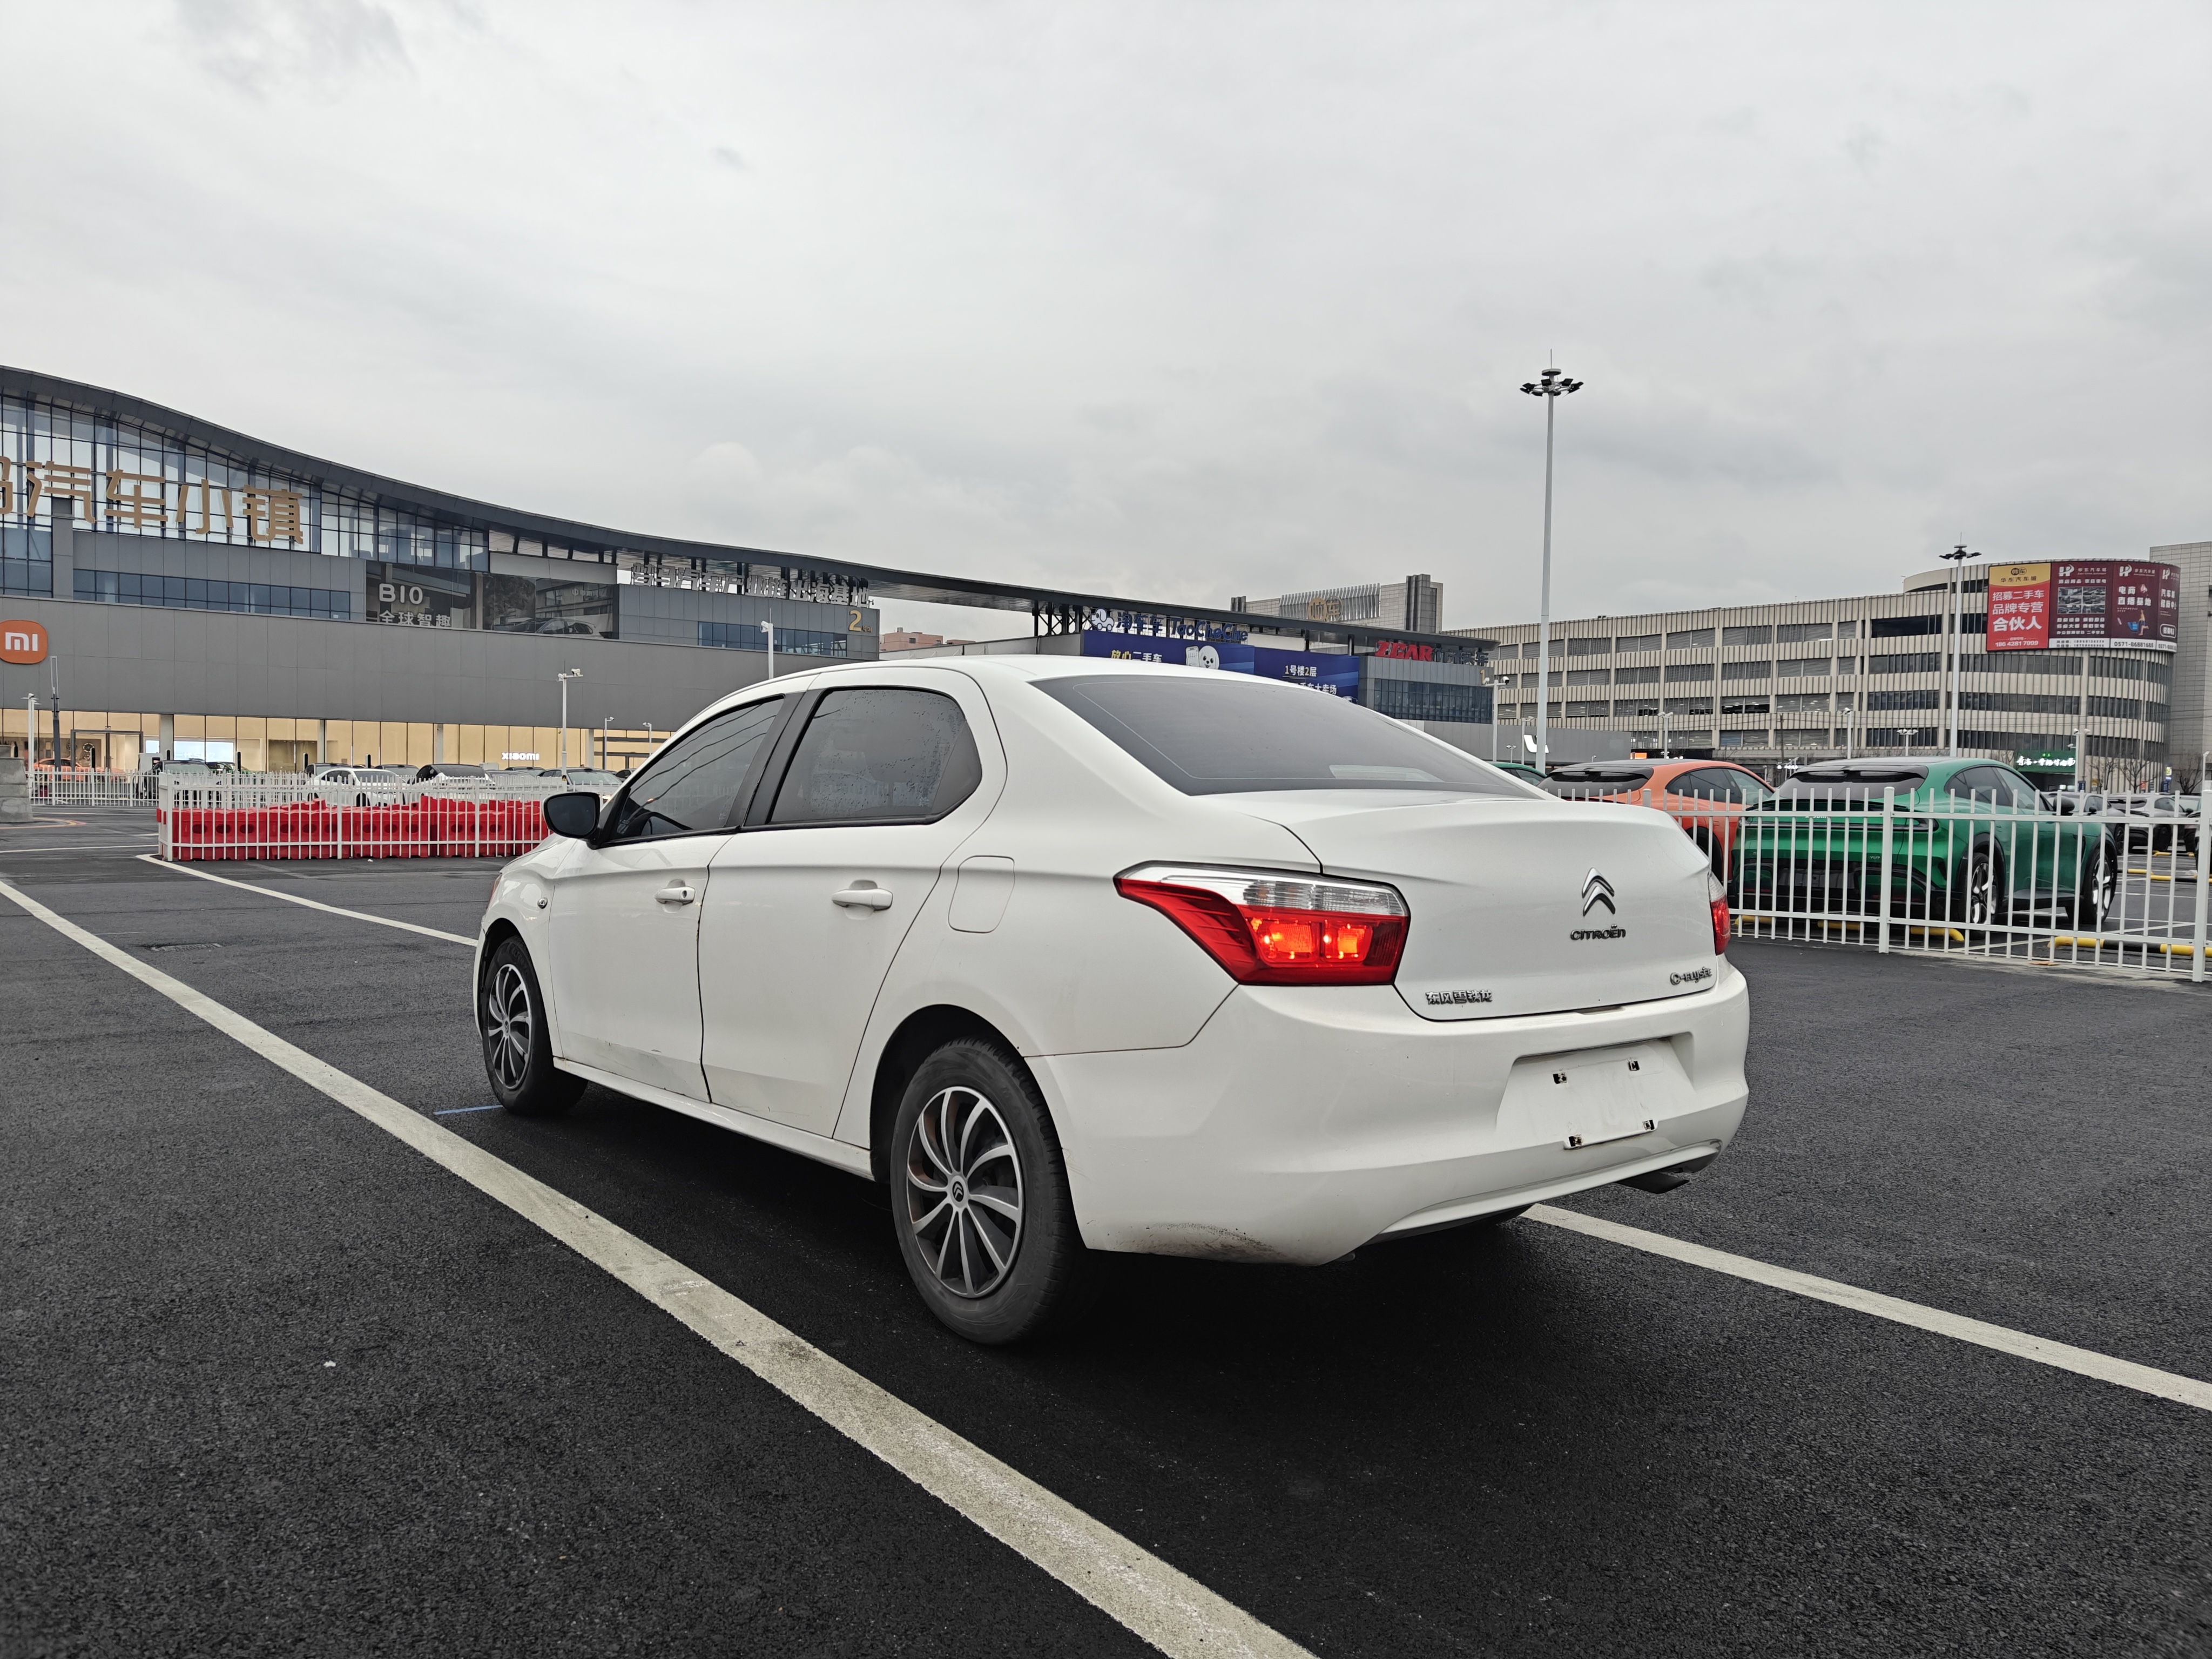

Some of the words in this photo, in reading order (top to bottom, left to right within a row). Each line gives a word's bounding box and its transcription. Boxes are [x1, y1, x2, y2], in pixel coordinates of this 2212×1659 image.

[0, 456, 304, 545] 汽车小镇
[1992, 589, 2045, 601] 招募二手车
[1992, 602, 2044, 615] 品牌专营
[379, 610, 452, 627] 全球智趣
[1993, 616, 2042, 632] 合伙人
[1111, 650, 1162, 663] 放心二手车
[1285, 665, 1317, 677] 1号楼2层
[1426, 989, 1493, 1005] 东风雪铁龙
